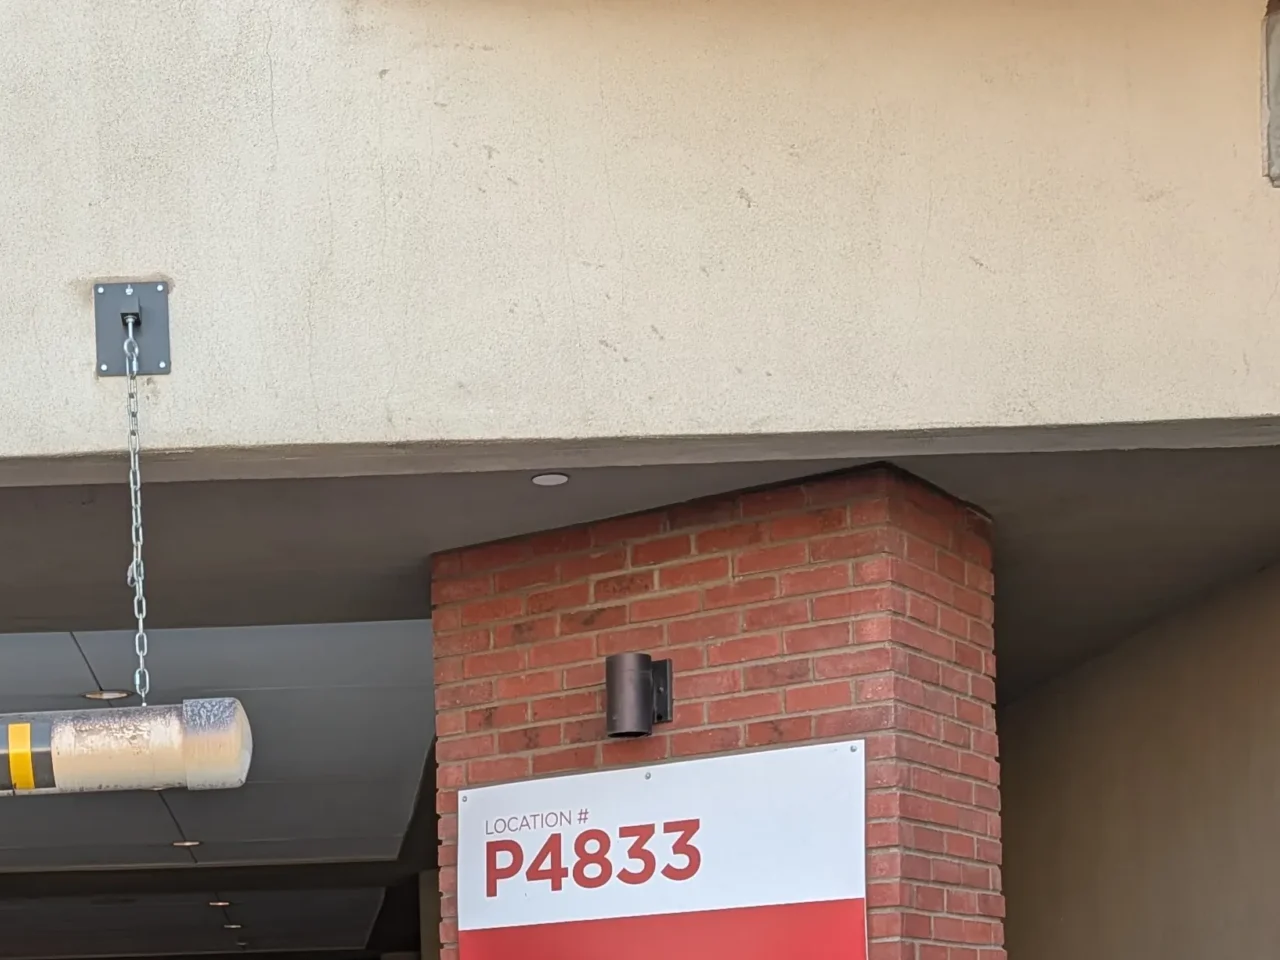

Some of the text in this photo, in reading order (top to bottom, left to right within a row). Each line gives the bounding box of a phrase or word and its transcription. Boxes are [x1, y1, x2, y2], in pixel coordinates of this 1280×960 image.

[485, 808, 589, 835] LOCATION #
[485, 818, 701, 898] P4833
